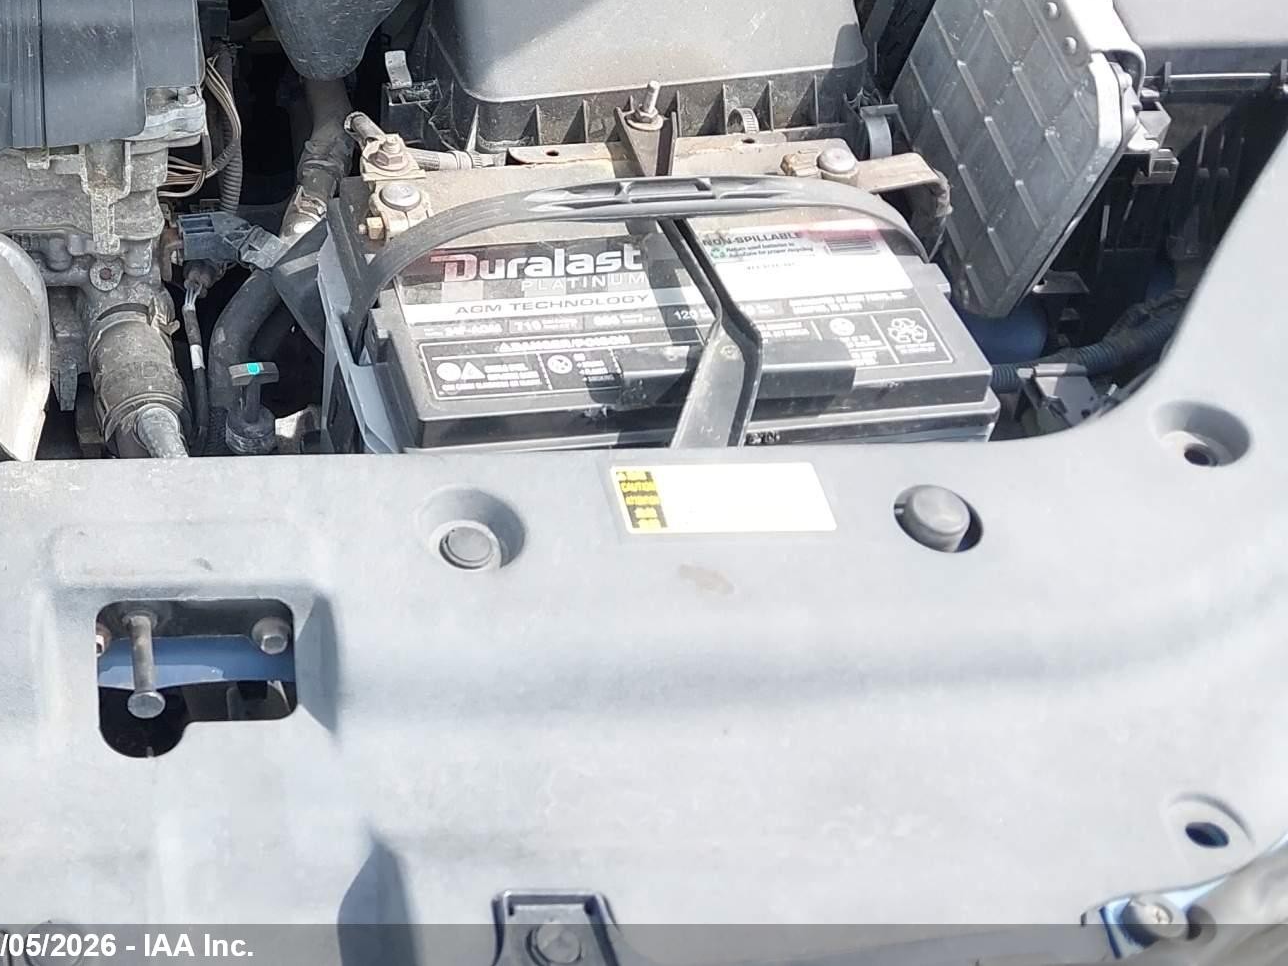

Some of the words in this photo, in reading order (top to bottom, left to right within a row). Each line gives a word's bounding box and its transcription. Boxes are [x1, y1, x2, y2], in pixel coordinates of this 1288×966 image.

[702, 230, 804, 247] NON-SPILLABLE
[430, 243, 645, 283] Duralast
[521, 272, 648, 292] PLATINUM
[455, 303, 502, 315] AGM
[509, 293, 650, 310] TECHNOLOGY
